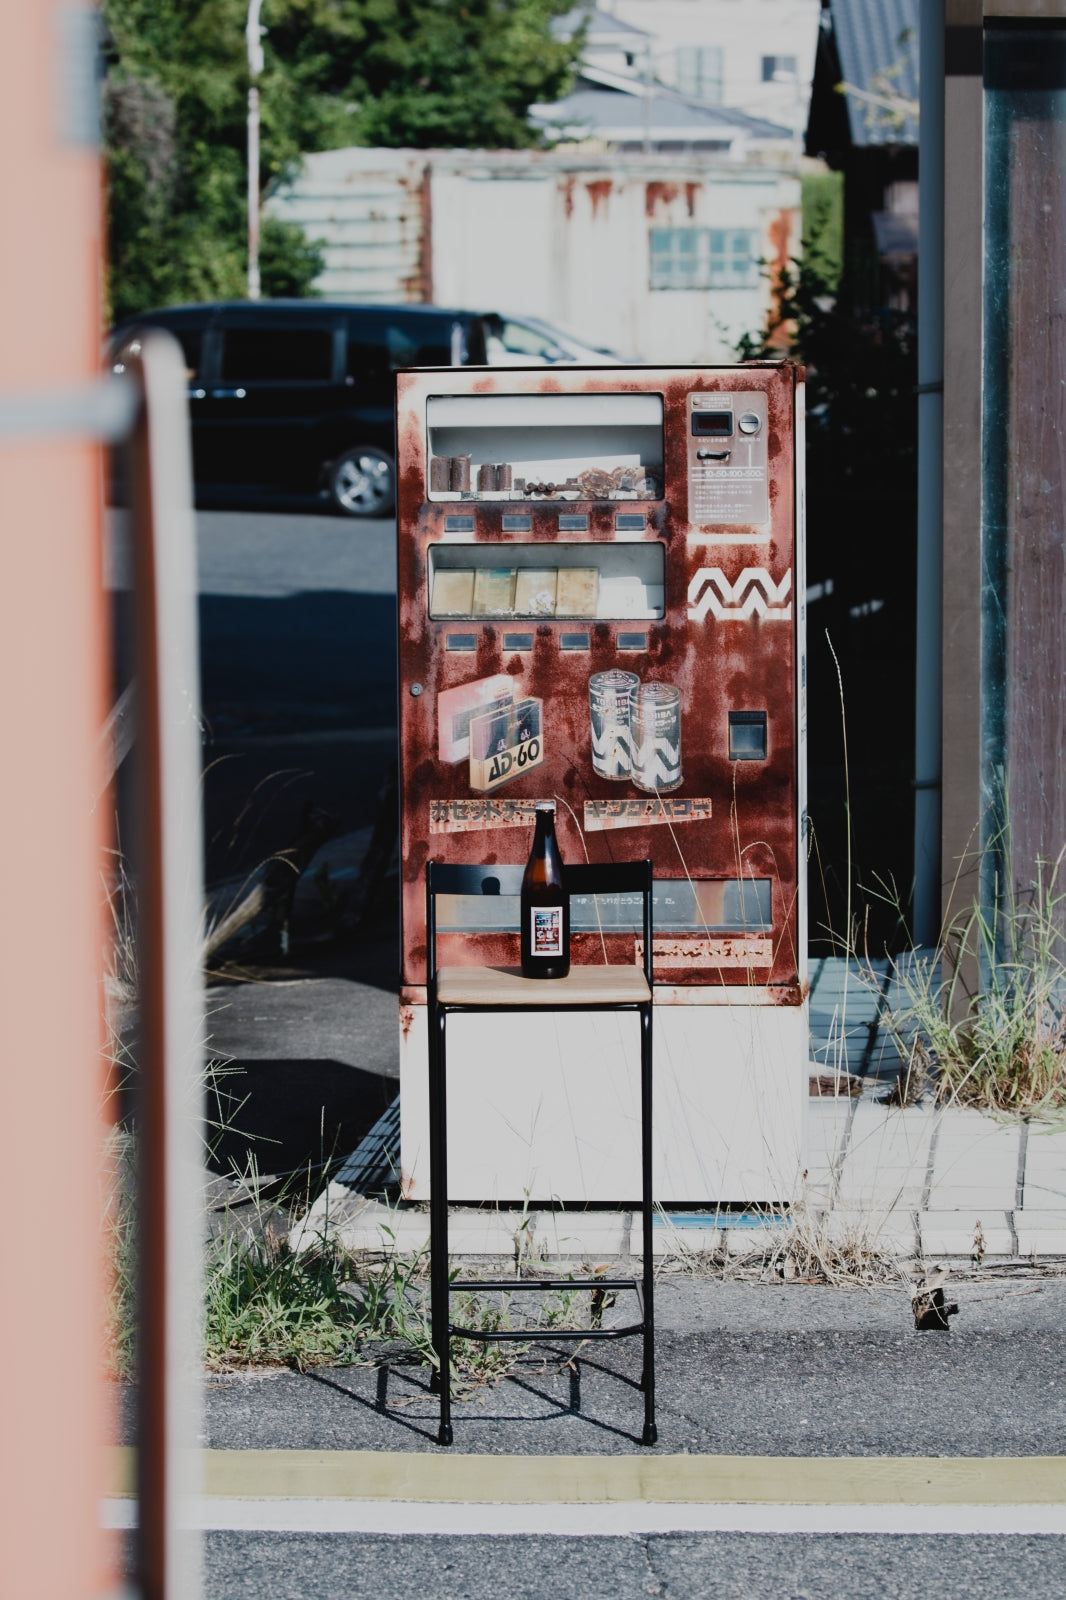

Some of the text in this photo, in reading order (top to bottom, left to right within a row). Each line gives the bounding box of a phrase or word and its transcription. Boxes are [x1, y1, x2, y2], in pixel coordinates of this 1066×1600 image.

[431, 800, 538, 821] カセットテー
